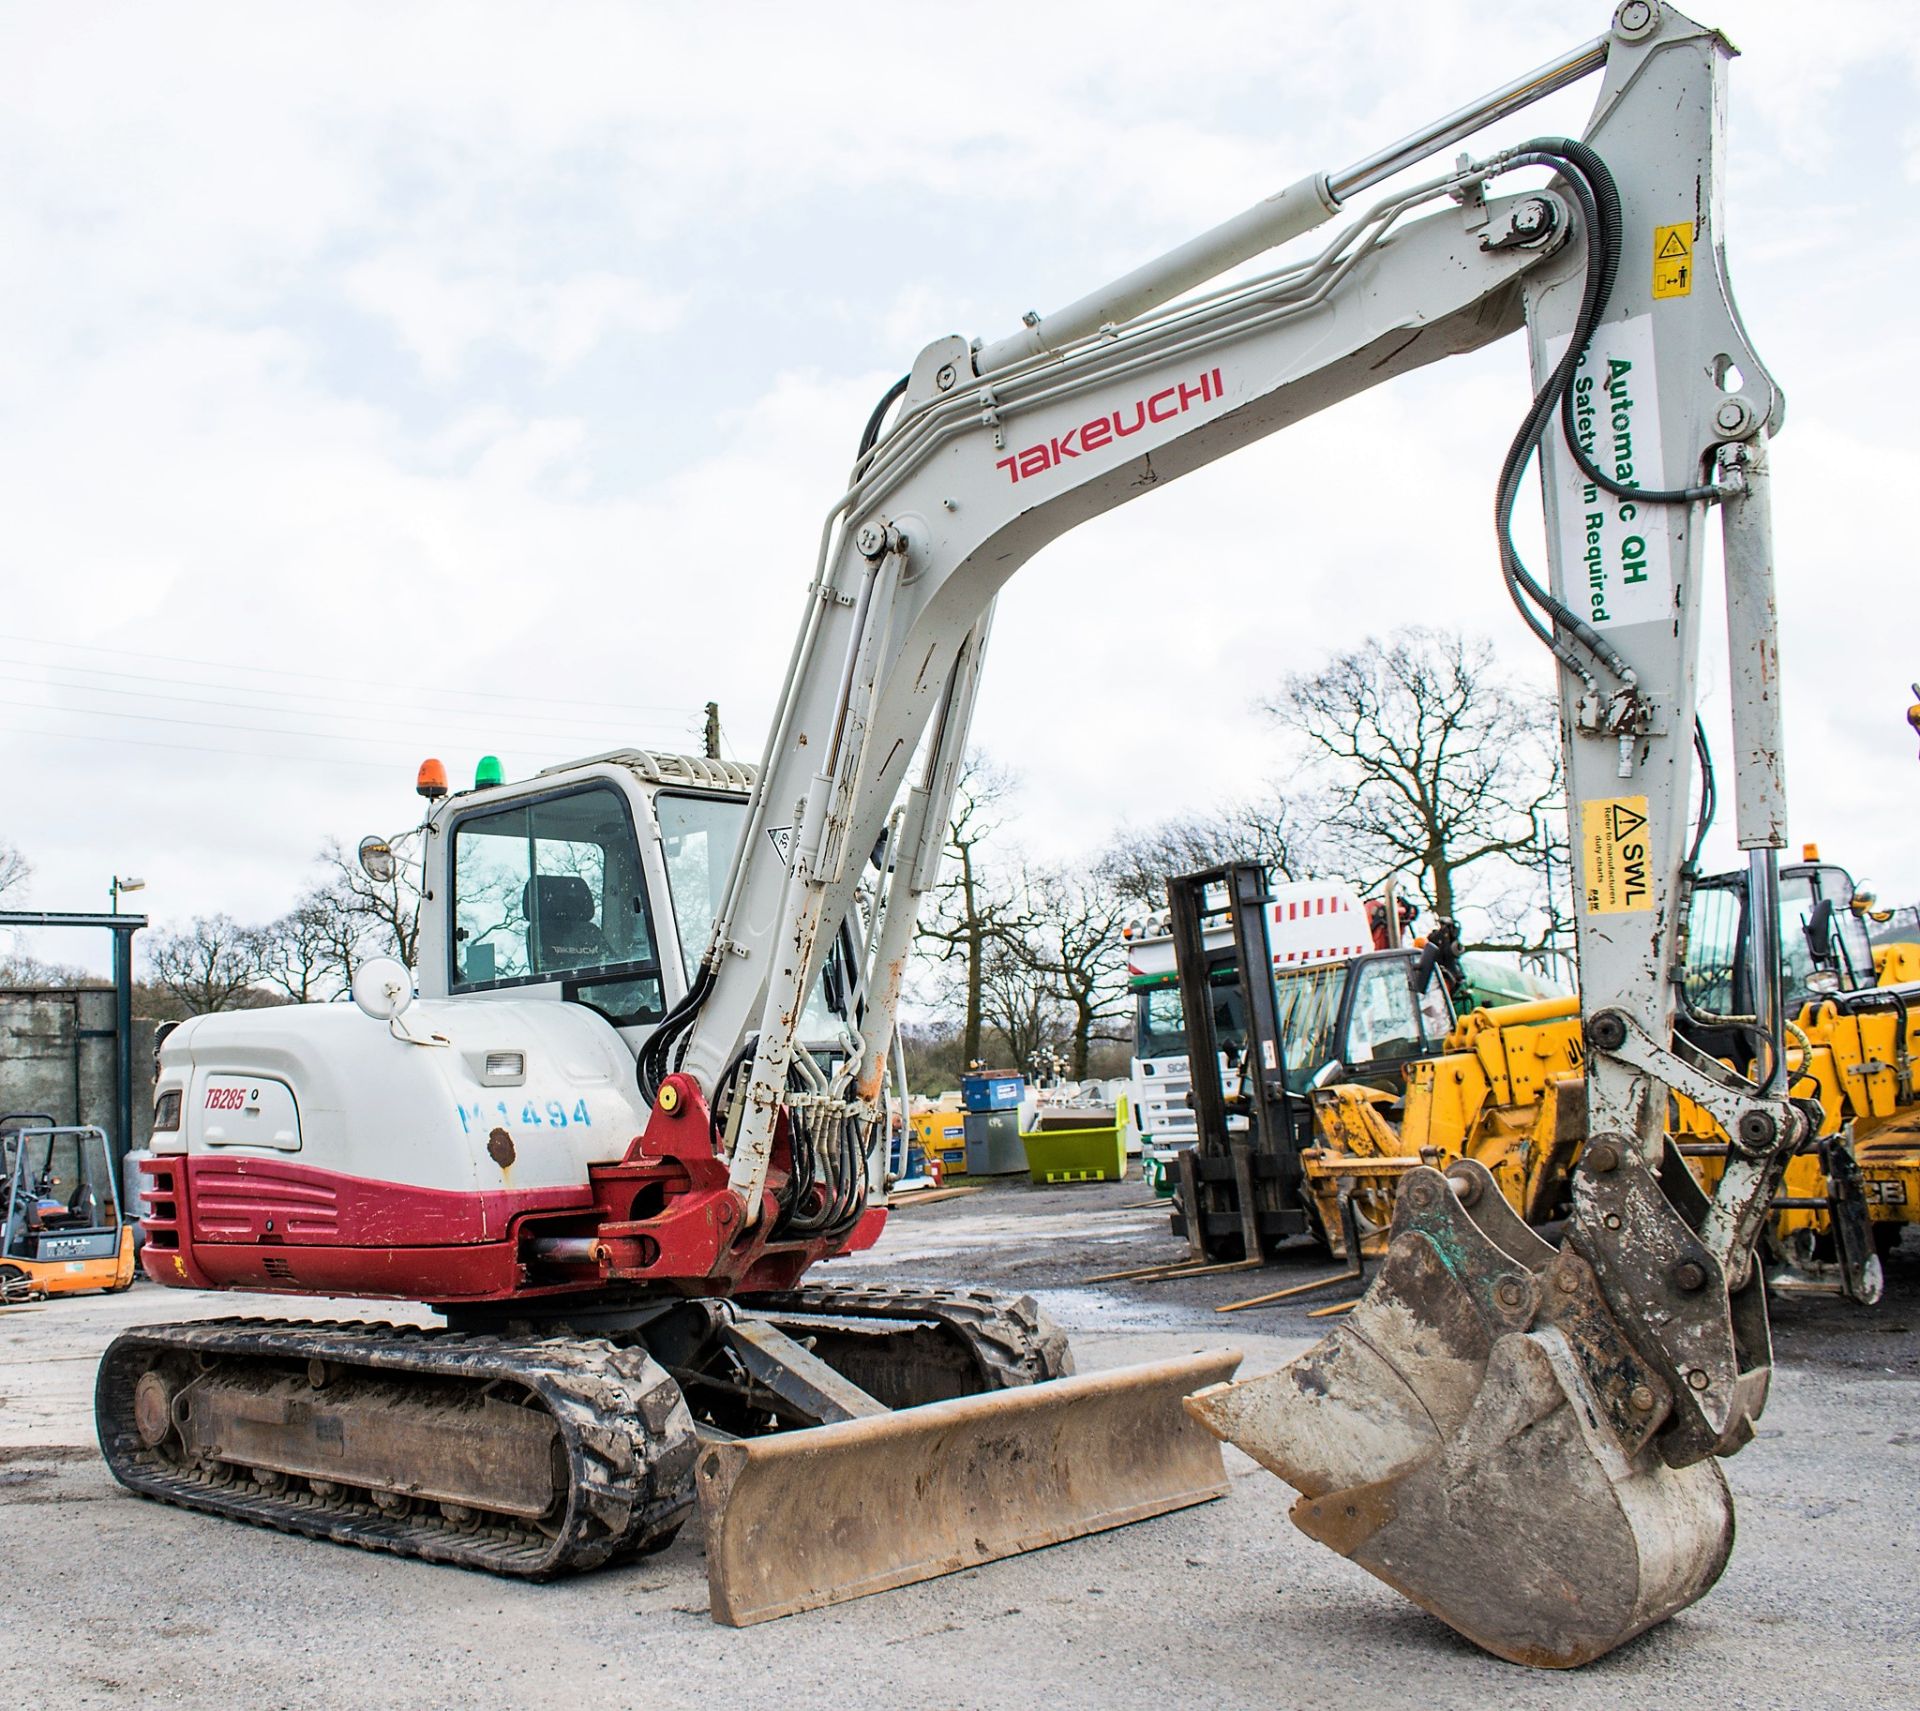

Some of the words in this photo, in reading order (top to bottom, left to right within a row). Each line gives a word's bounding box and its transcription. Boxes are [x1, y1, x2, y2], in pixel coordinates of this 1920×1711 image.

[1608, 358, 1640, 522] Automatc
[1584, 512, 1611, 623] Required
[1621, 536, 1648, 585] QH
[1604, 807, 1613, 830] Refer
[1594, 835, 1602, 854] duty
[1606, 832, 1613, 841] to
[1596, 856, 1604, 883] charts
[1606, 843, 1616, 905] manufacturers
[1623, 844, 1646, 906] SWL
[204, 1088, 247, 1110] TB285
[46, 1239, 91, 1248] STILL
